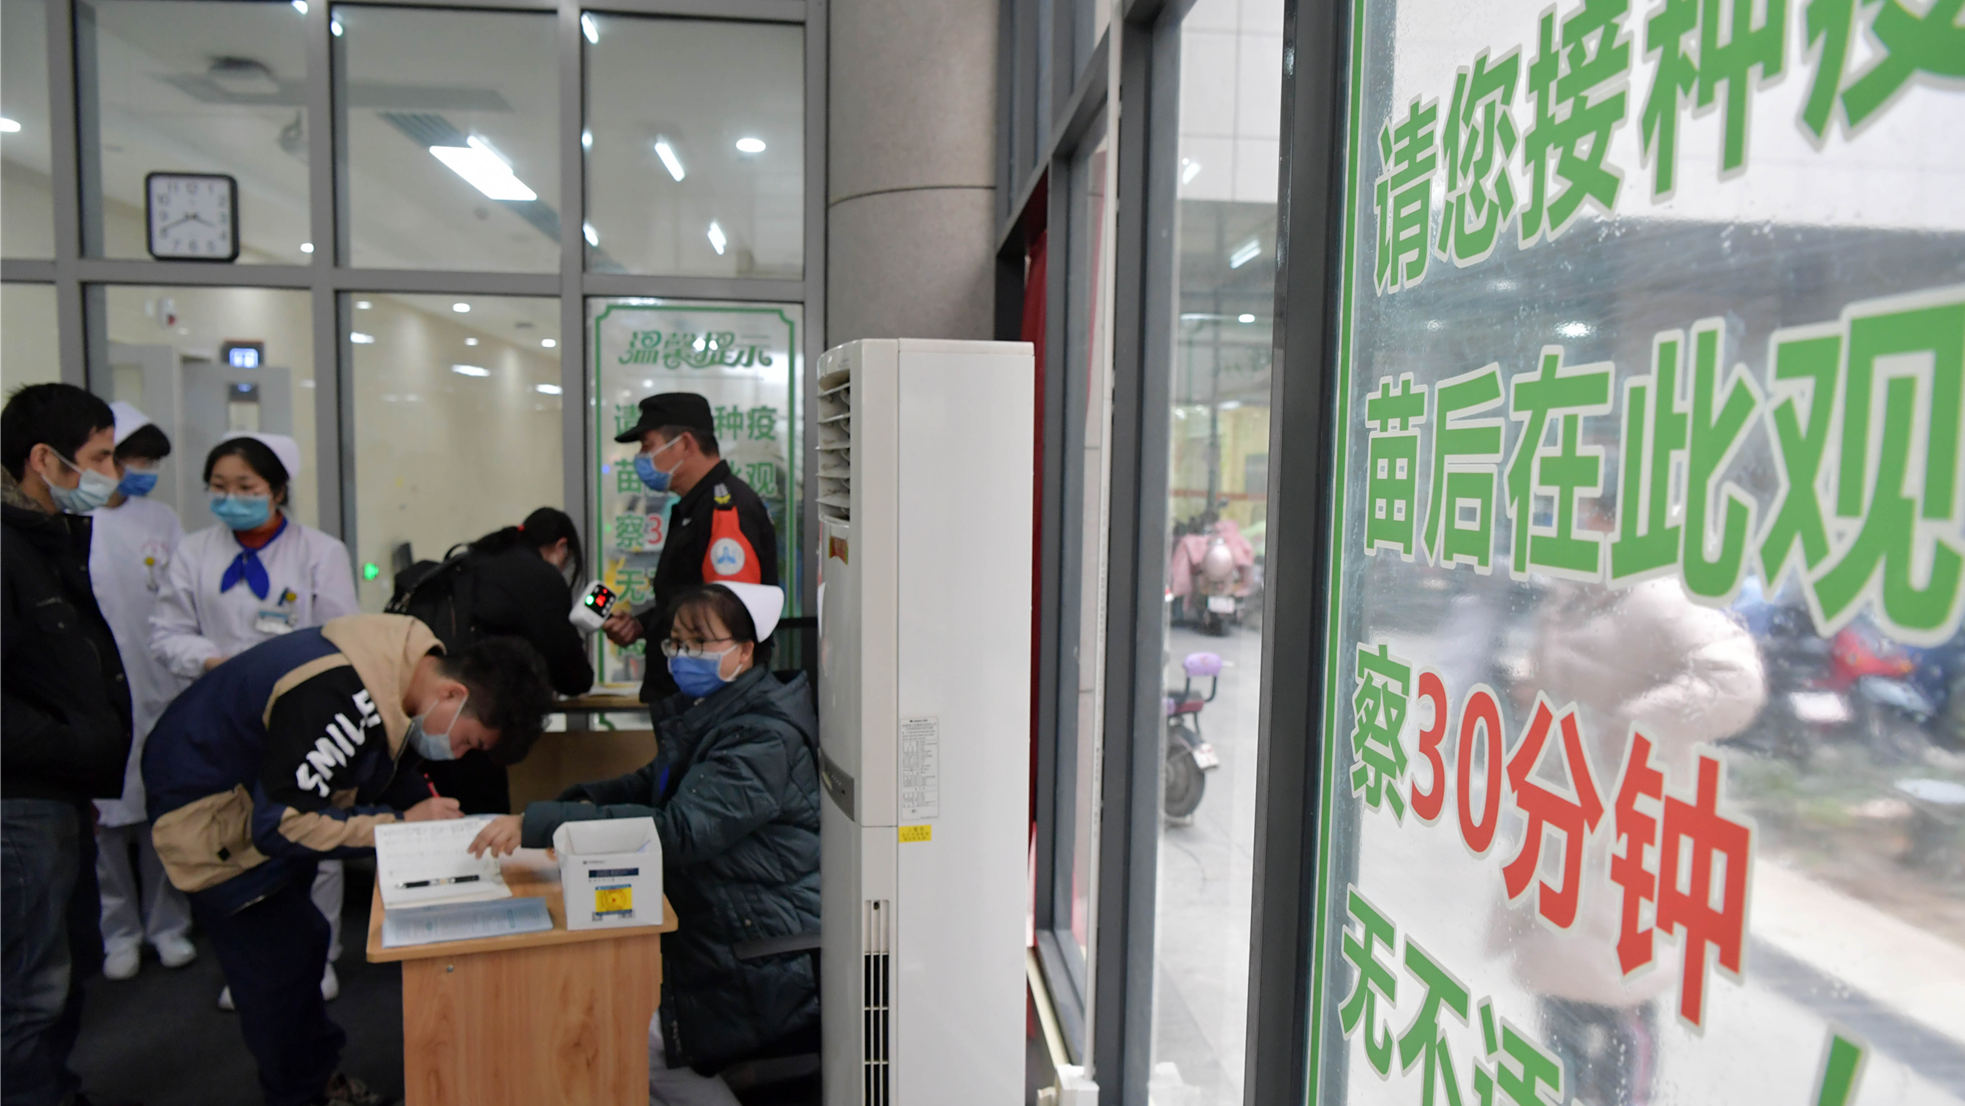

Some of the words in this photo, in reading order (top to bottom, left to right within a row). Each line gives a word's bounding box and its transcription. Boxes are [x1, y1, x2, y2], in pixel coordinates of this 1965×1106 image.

[1364, 285, 1965, 645] 苗后在此观
[296, 689, 380, 797] SMILE
[1351, 640, 1757, 1035] 察30分钟
